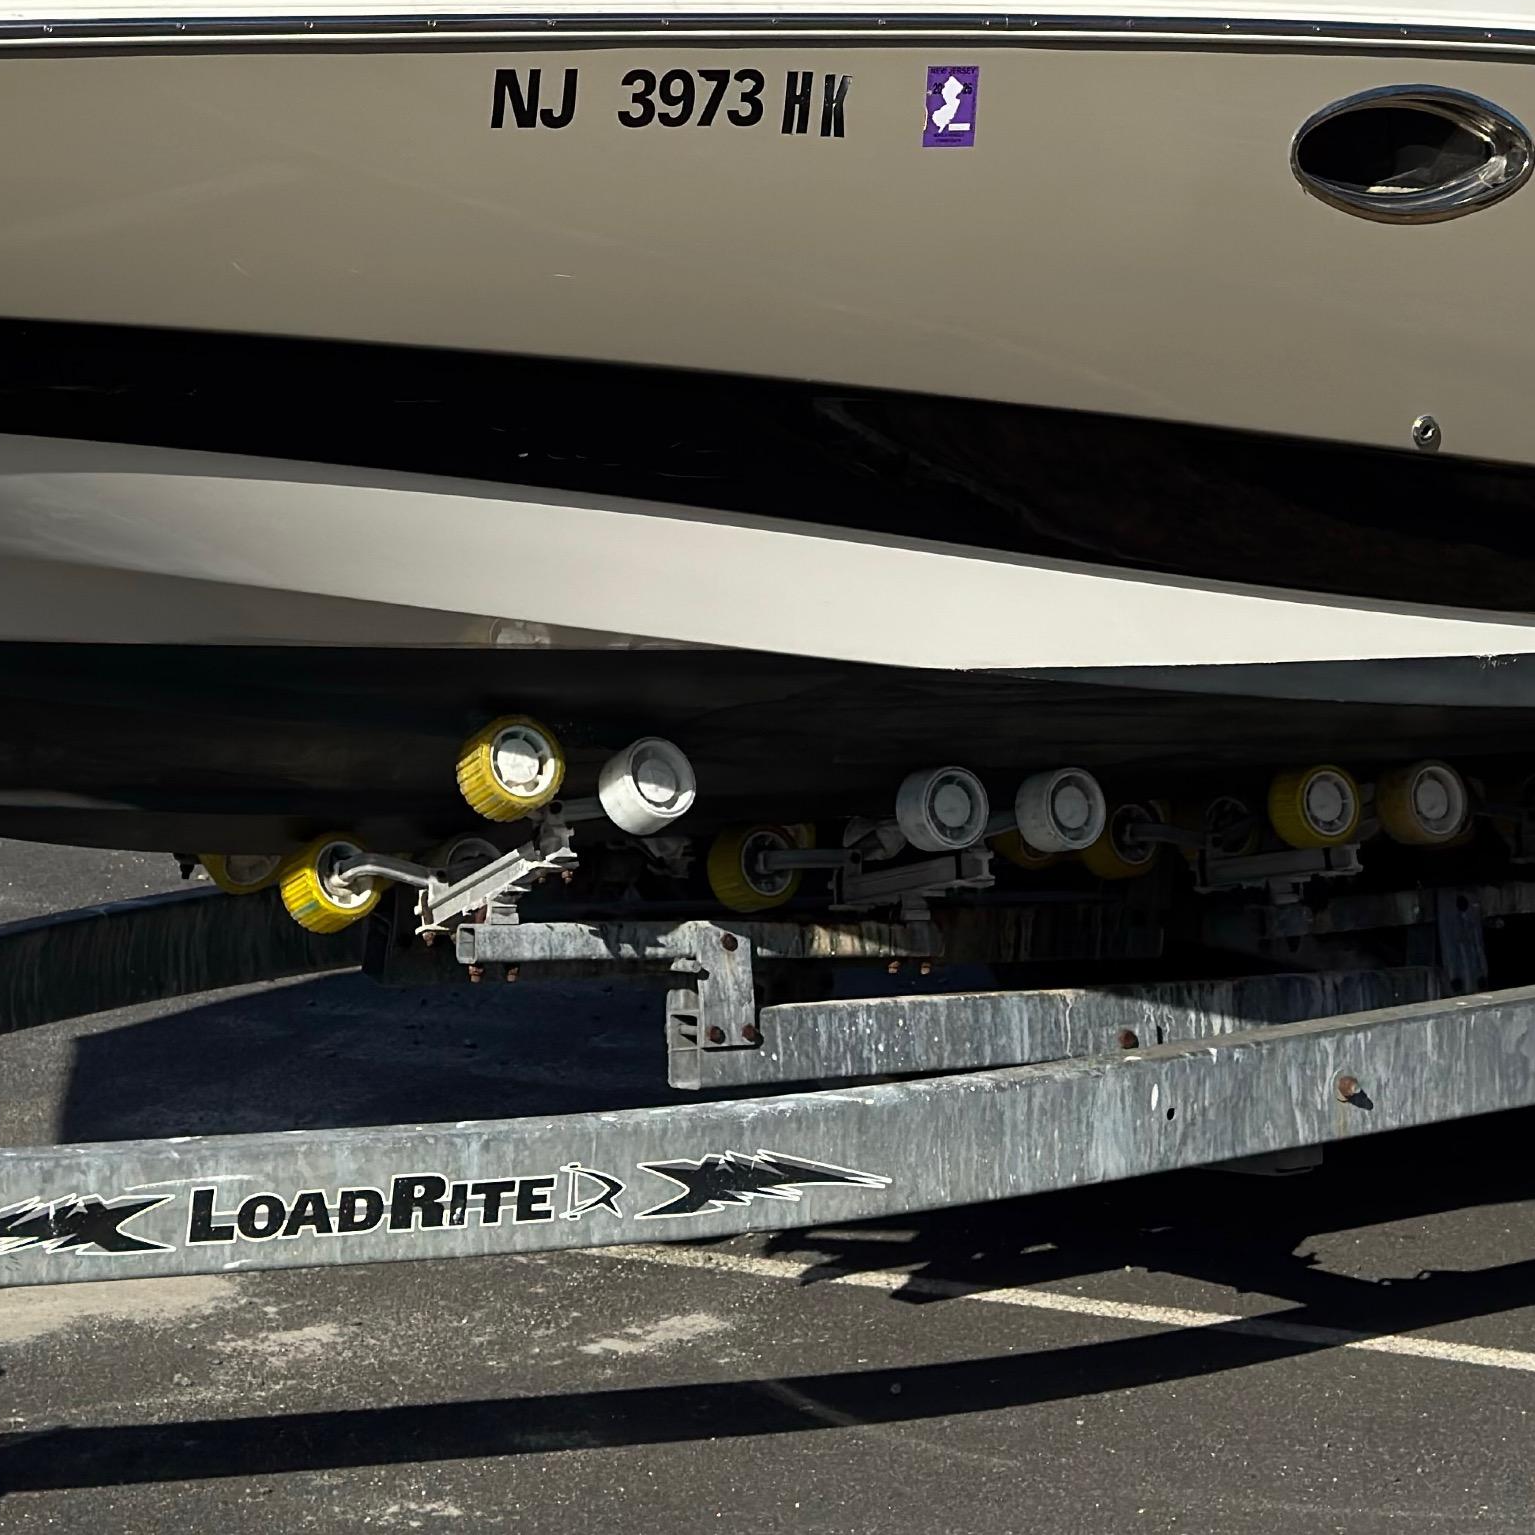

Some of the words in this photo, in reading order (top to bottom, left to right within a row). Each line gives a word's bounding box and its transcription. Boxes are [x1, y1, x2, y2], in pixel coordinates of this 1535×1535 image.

[490, 68, 579, 129] NJ
[617, 68, 765, 128] 3973
[780, 70, 854, 139] HK
